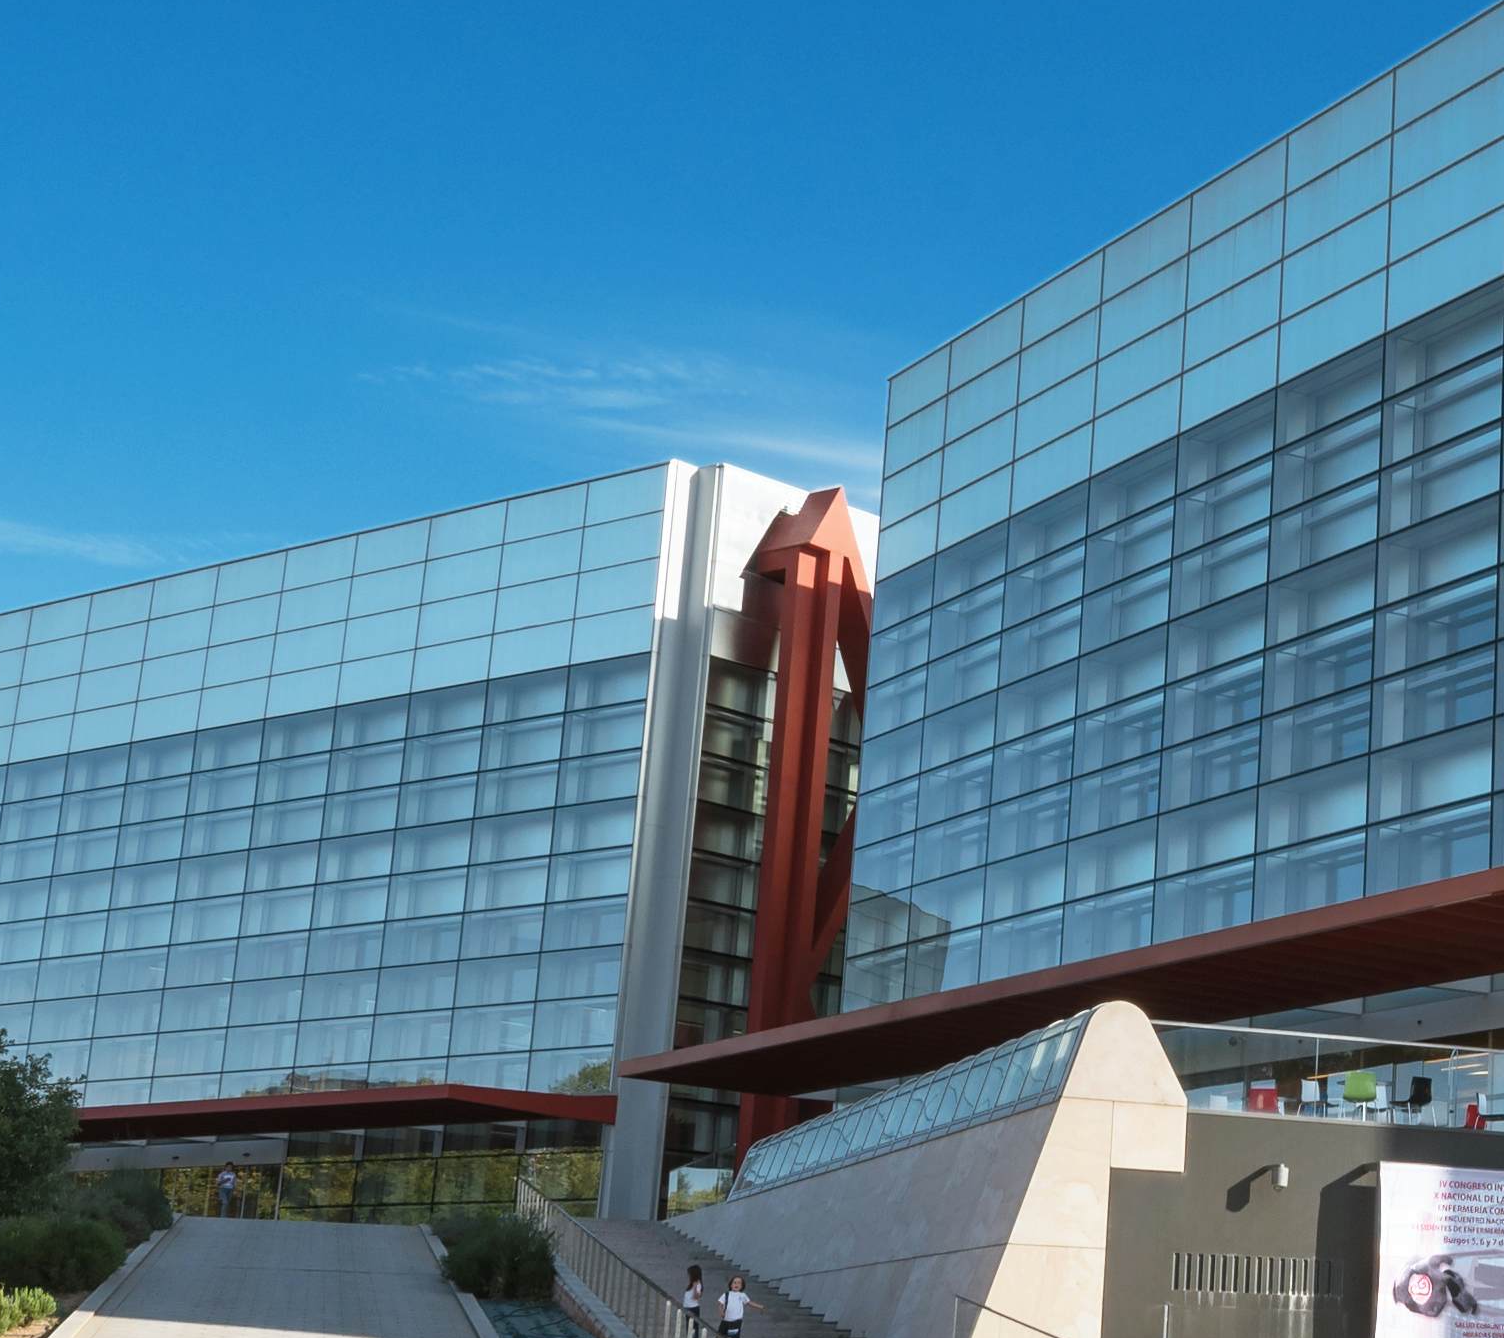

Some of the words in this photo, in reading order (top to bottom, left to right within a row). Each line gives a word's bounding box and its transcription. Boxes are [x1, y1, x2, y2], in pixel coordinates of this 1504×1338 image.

[1449, 1180, 1493, 1191] CONGRESO
[1441, 1192, 1482, 1203] NACIONAL
[1484, 1194, 1494, 1203] DE
[1443, 1236, 1469, 1246] Burgos
[1486, 1239, 1492, 1248] y
[1492, 1238, 1497, 1246] 7
